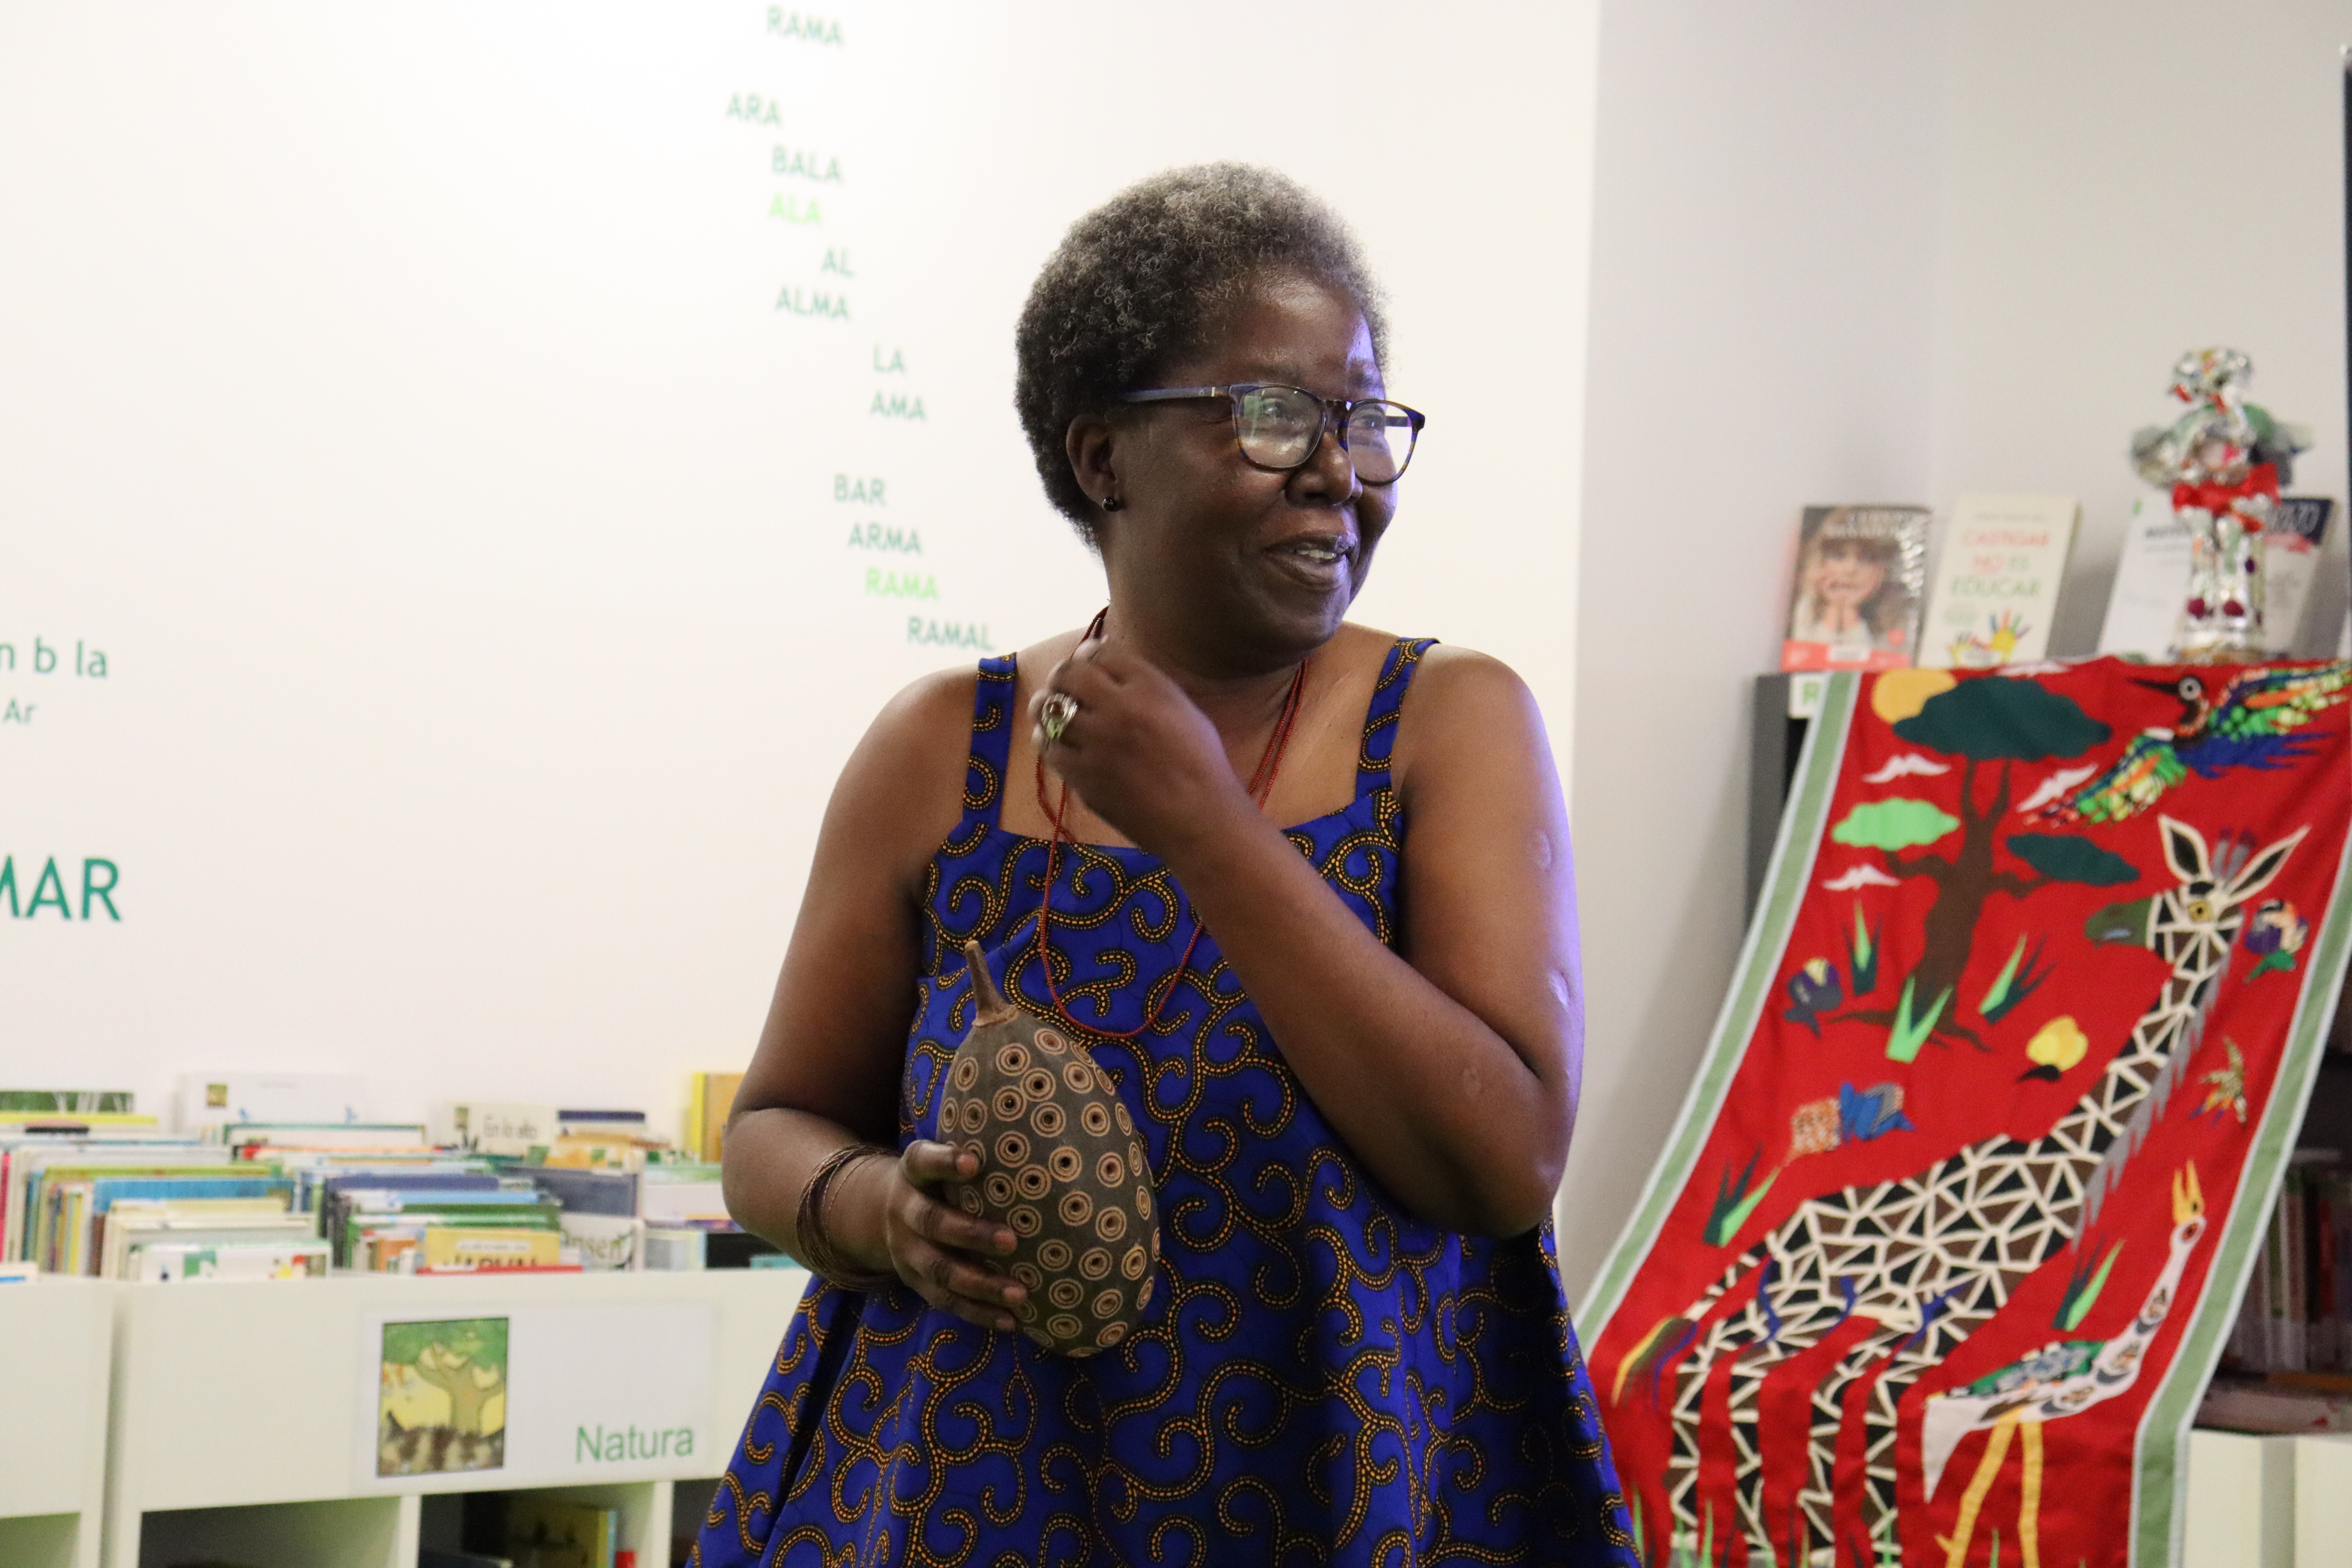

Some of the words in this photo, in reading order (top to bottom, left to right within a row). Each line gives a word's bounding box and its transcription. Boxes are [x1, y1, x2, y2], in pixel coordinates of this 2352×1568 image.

[767, 5, 844, 45] RAMA
[726, 93, 782, 126] ARA
[772, 144, 842, 182] BALA
[769, 193, 822, 225] ALA
[821, 248, 854, 278] AL
[776, 287, 849, 319] ALMA
[873, 346, 906, 374] LA
[871, 392, 925, 419] AMA
[834, 474, 885, 505] BAR
[848, 523, 922, 555] ARMA
[866, 567, 938, 600] RAMA
[907, 616, 993, 651] RAMAL
[3, 697, 36, 723] Ar
[575, 1425, 694, 1463] Natura
